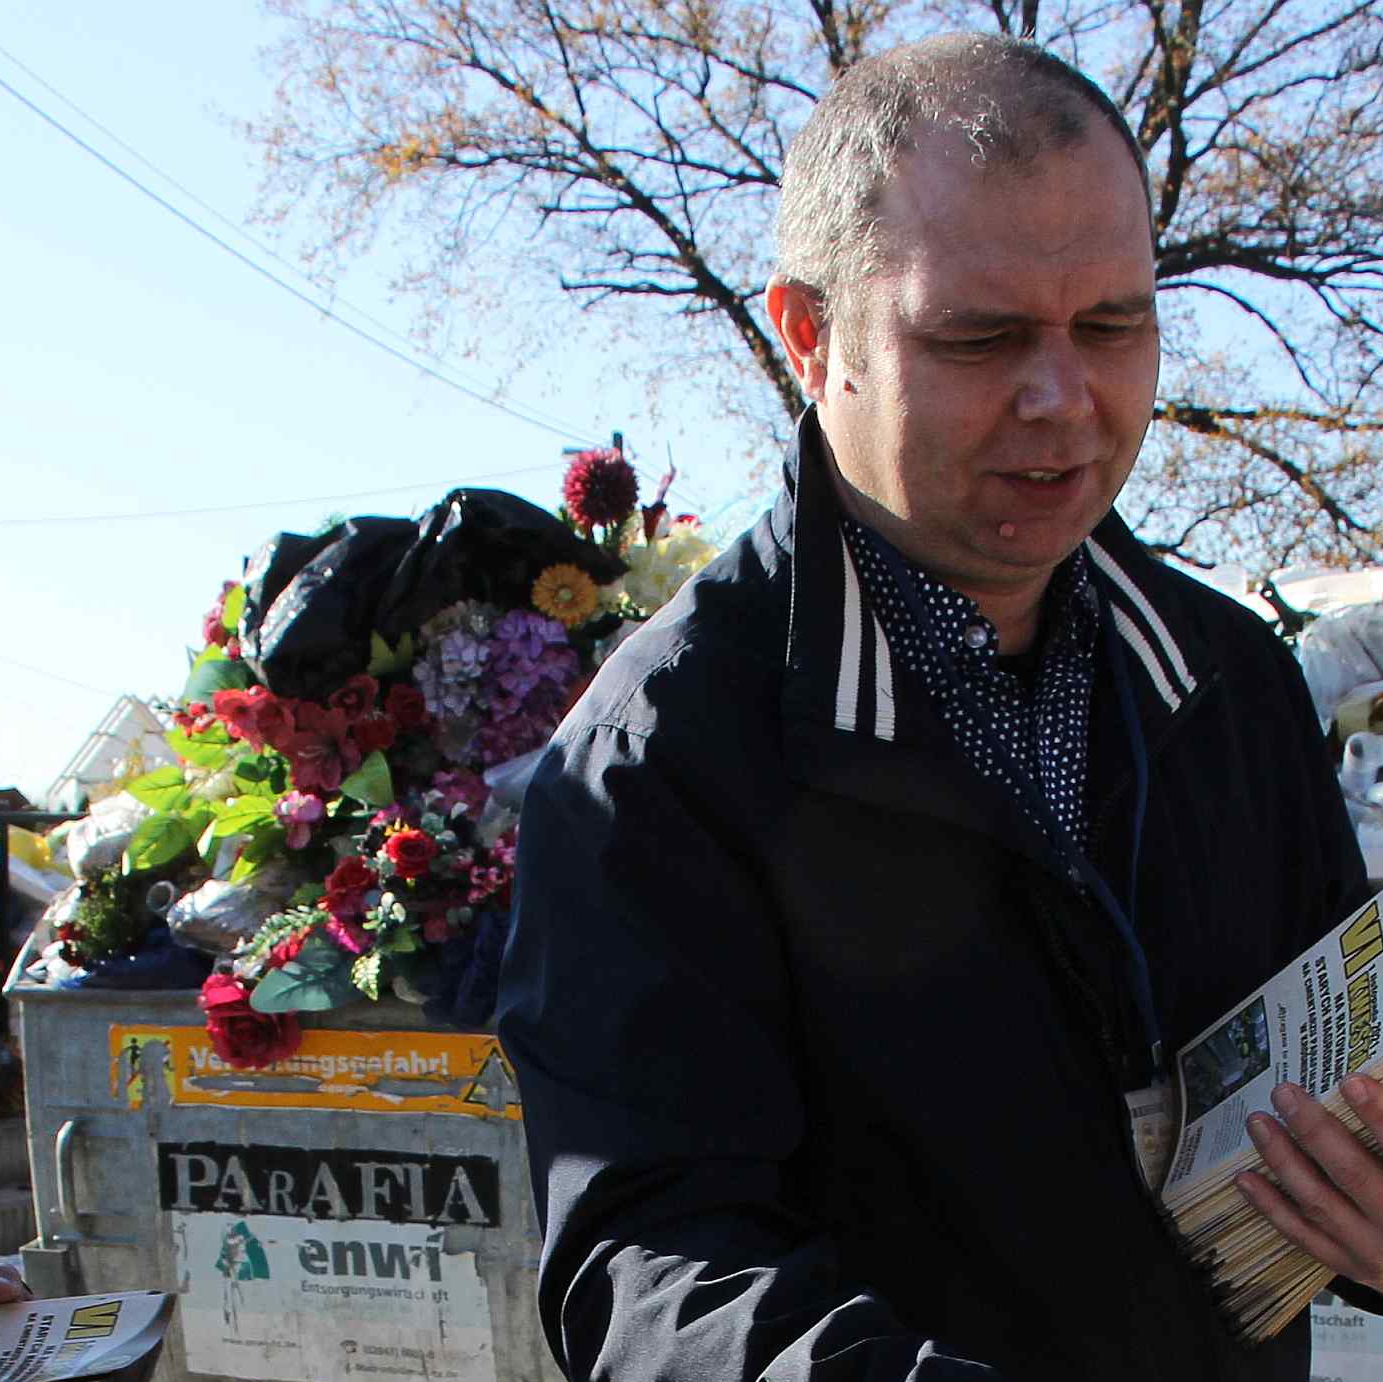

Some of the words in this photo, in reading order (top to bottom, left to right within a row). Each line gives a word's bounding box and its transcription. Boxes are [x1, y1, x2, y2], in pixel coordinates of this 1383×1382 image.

[1302, 961, 1311, 978] NA
[1315, 955, 1331, 1017] STARYCH
[1334, 992, 1346, 1013] NA
[1347, 971, 1370, 1075] KWESTA
[190, 1046, 449, 1078] Veungsgefahr!
[1321, 1015, 1332, 1094] NAGROBKÓW
[170, 1153, 490, 1223] PARAFIA
[299, 1232, 444, 1281] enwi
[65, 1300, 122, 1340] VI
